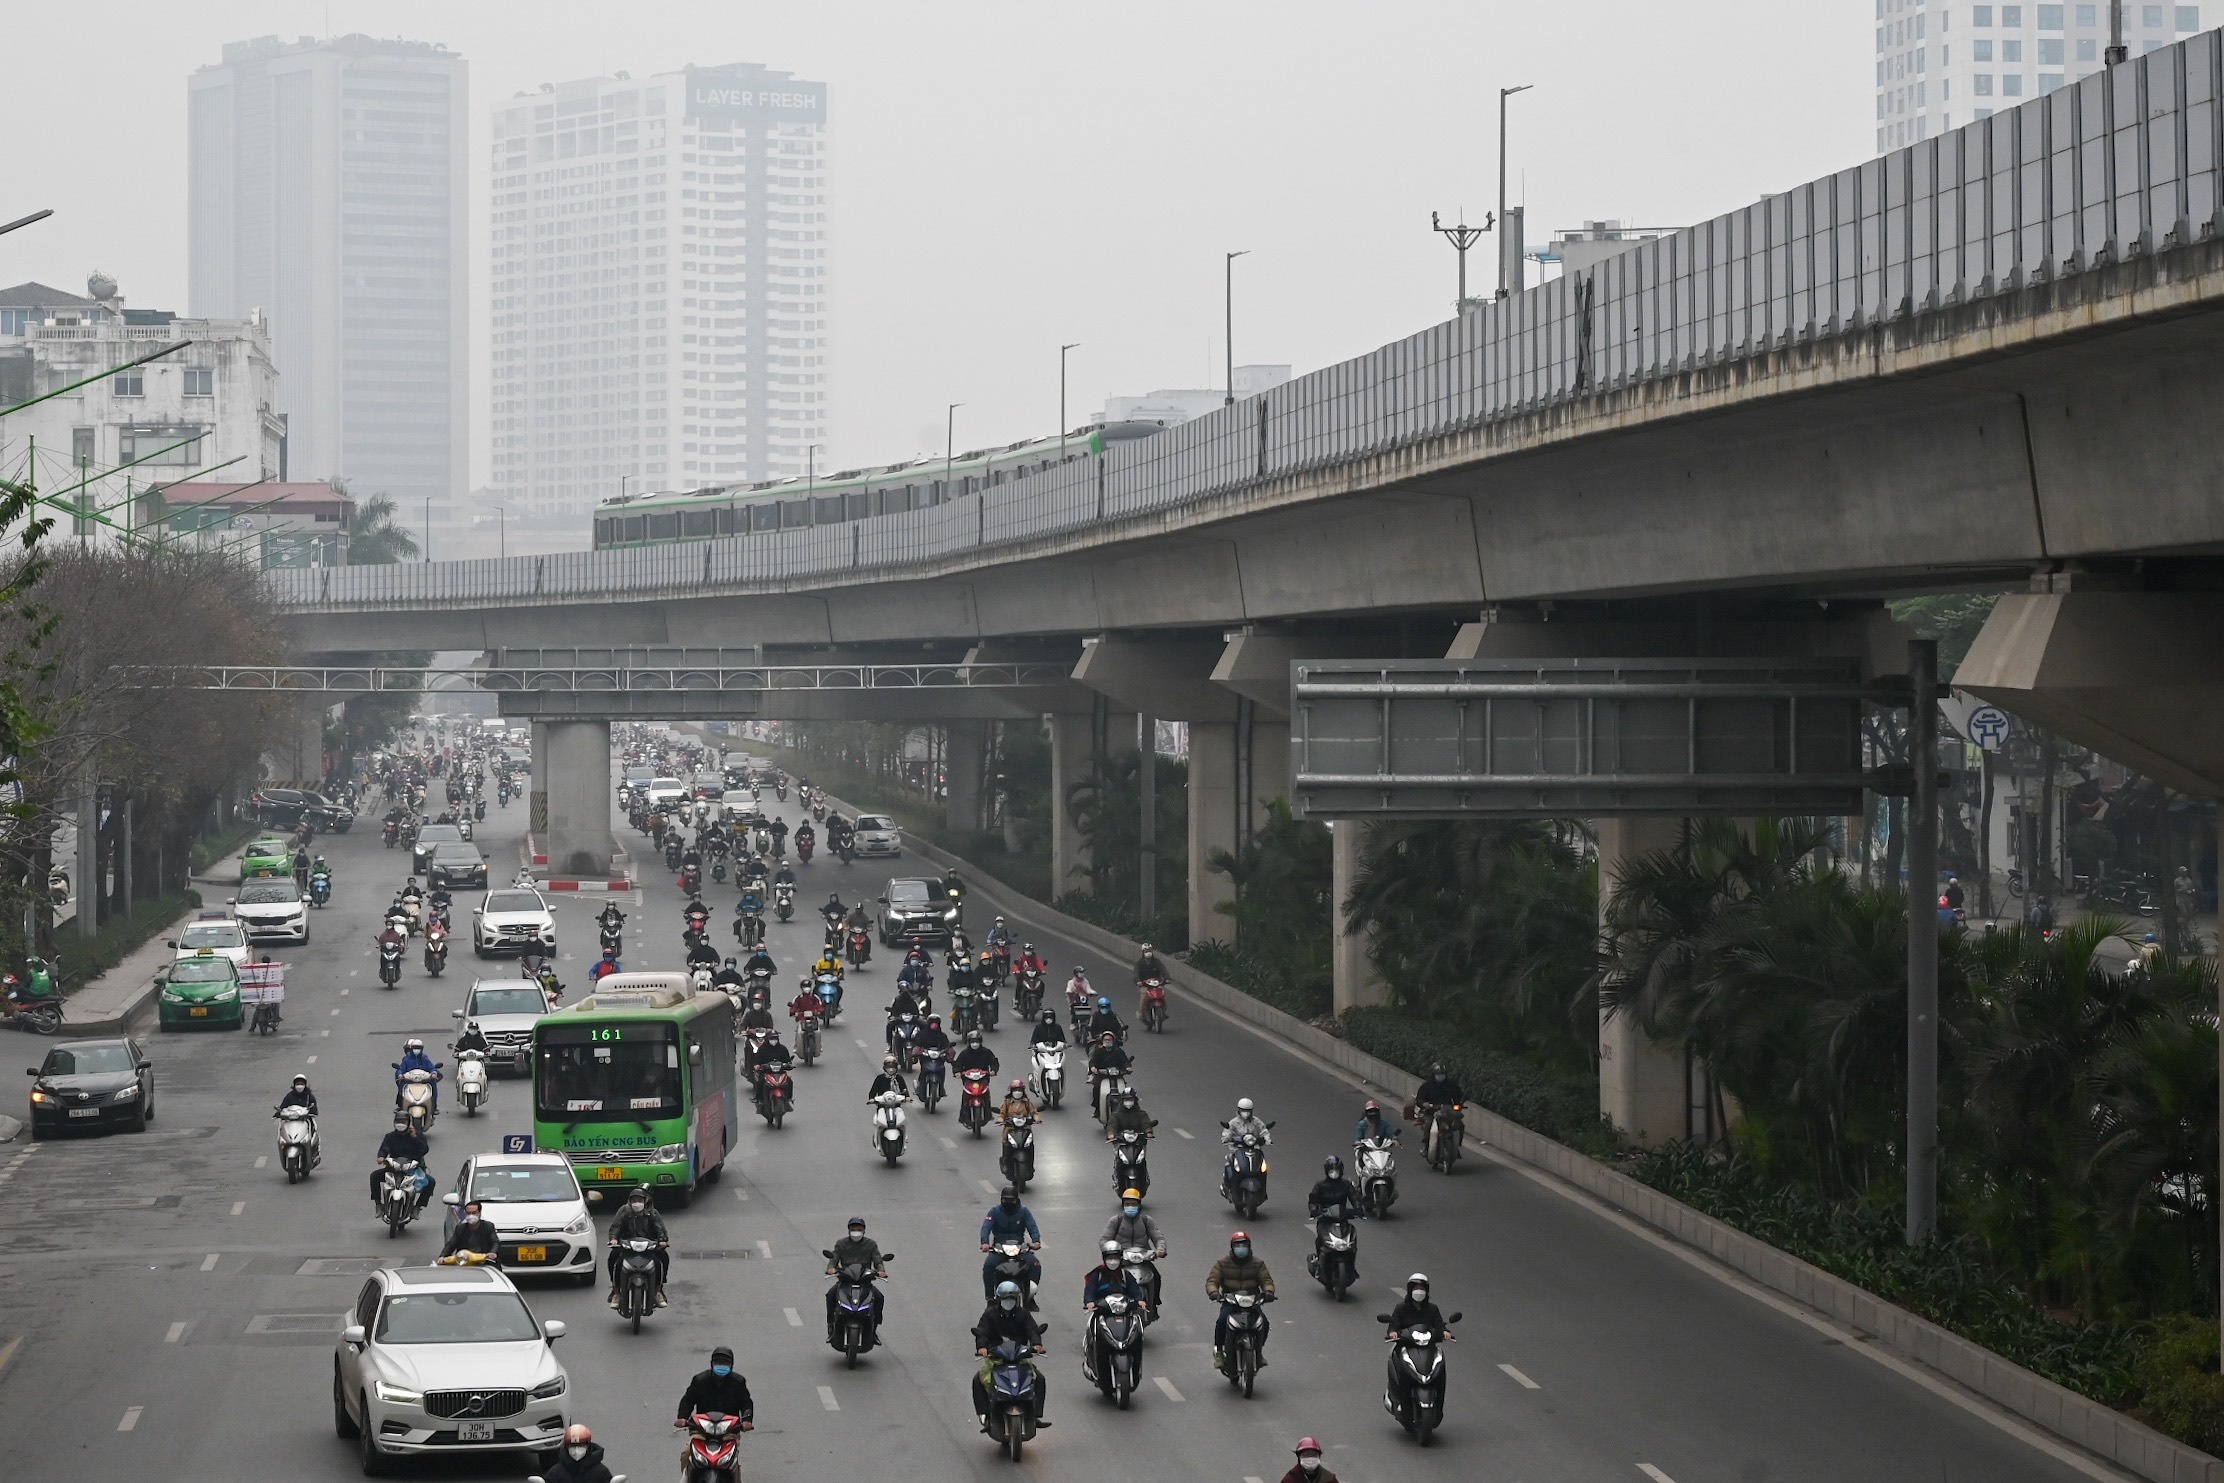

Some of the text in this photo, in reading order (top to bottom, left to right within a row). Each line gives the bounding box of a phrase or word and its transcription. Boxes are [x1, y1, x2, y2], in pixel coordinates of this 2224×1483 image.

[696, 88, 816, 109] LAYER FRESH
[591, 1029, 621, 1041] 161
[510, 1137, 525, 1151] G7
[564, 1134, 656, 1147] BẢO YẾN CNG BUS
[469, 1423, 484, 1431] 30H
[463, 1431, 490, 1440] 136.75
